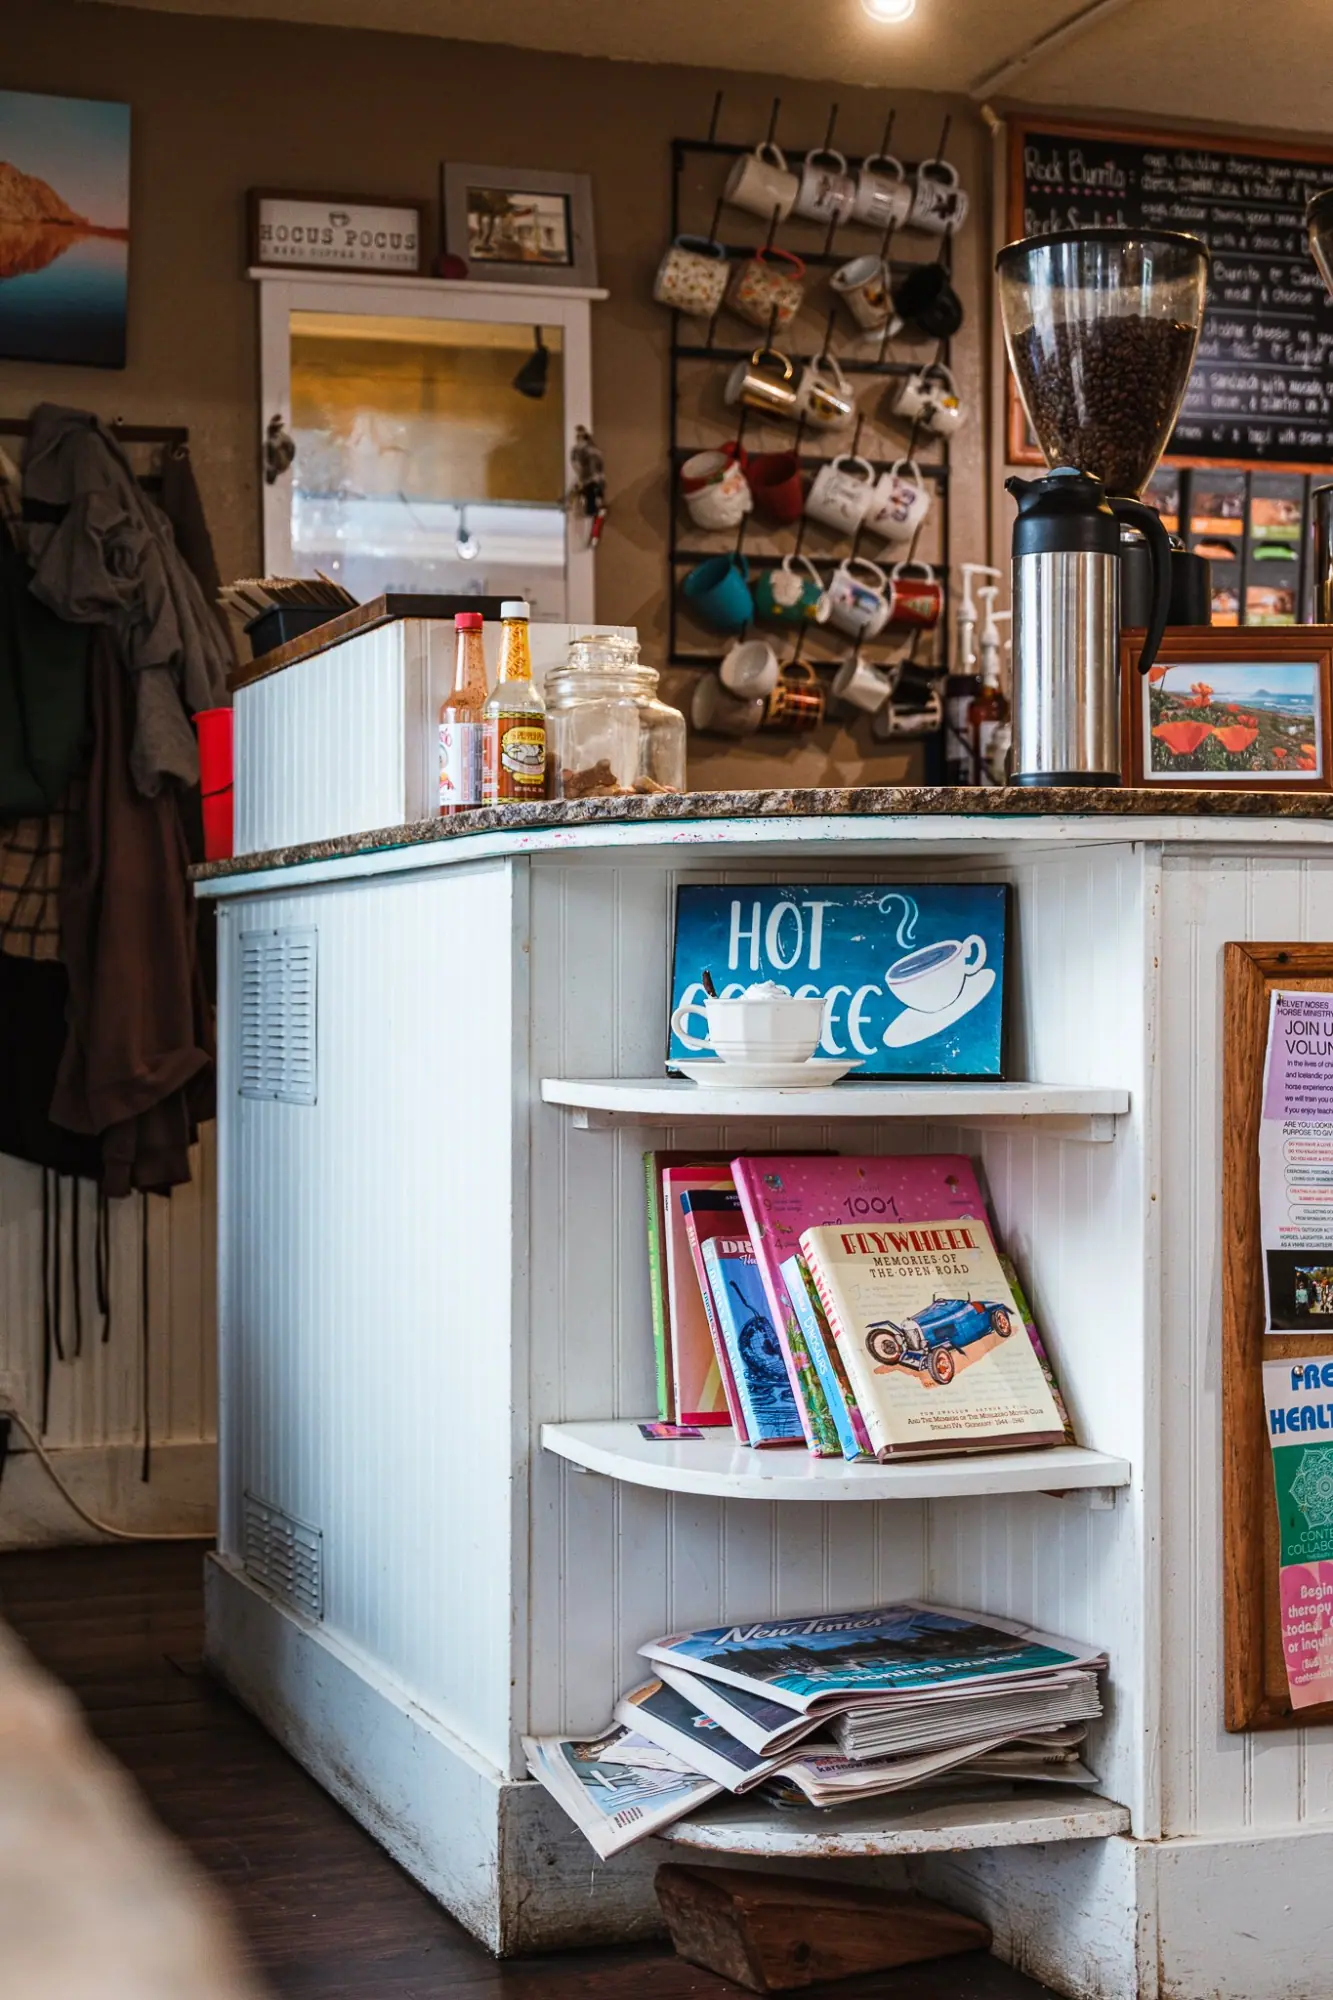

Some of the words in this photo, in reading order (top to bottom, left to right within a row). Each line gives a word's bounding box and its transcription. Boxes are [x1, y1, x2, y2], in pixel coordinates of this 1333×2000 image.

[260, 223, 333, 246] HOCUS
[345, 229, 416, 251] POCUS
[728, 900, 830, 971] HOT
[1277, 1008, 1302, 1017] HORSE
[1305, 1001, 1329, 1009] NOSES
[679, 982, 884, 1056] CEE
[1285, 1020, 1319, 1036] JOIN
[1295, 1094, 1304, 1102] will
[1289, 1107, 1300, 1115] you
[1300, 1107, 1316, 1115] enjoy
[1282, 1128, 1312, 1136] PURPOSE
[1283, 1120, 1297, 1129] ARE
[1297, 1121, 1311, 1129] YOU
[843, 1195, 901, 1218] 1001
[841, 1228, 980, 1255] FLYWHEEL
[873, 1255, 937, 1267] MEMORIES
[939, 1253, 958, 1264] OF
[869, 1267, 895, 1279] THE
[900, 1265, 932, 1277] OPEN
[936, 1264, 970, 1275] ROAD
[803, 1315, 828, 1377] DINOSAURS
[1300, 1583, 1333, 1600] Begin
[1288, 1602, 1331, 1619] therapy
[713, 1623, 798, 1646] New
[800, 1617, 882, 1638] Times
[1288, 1641, 1299, 1653] or
